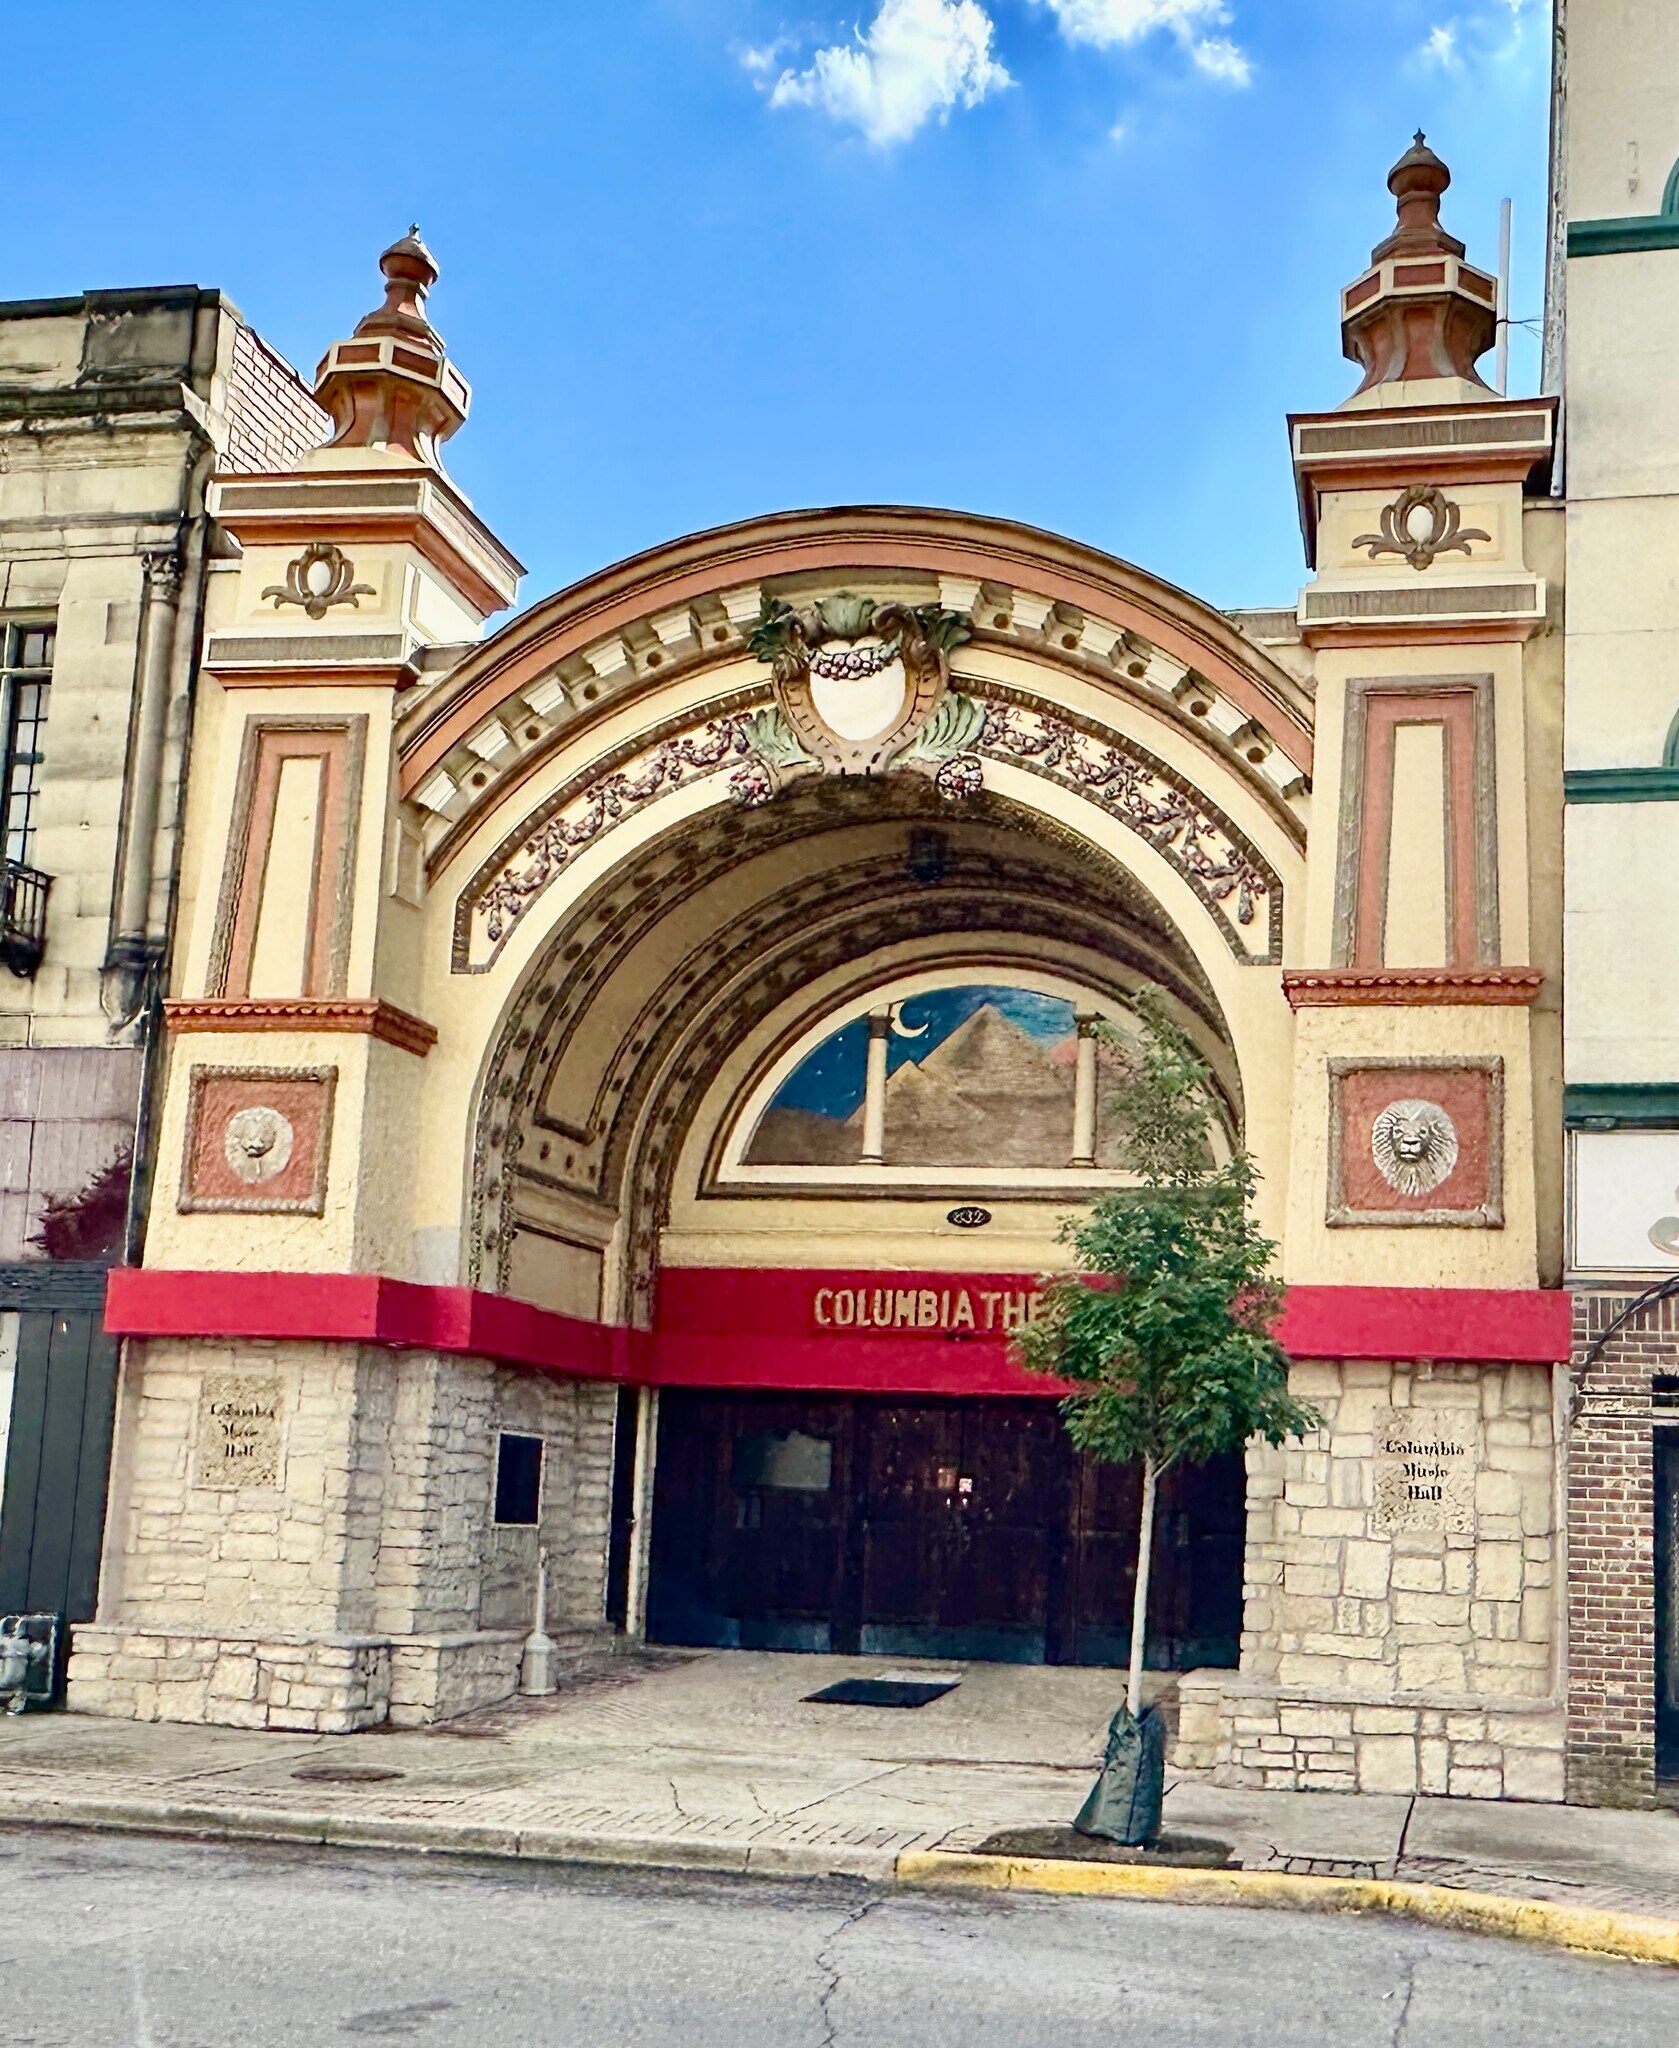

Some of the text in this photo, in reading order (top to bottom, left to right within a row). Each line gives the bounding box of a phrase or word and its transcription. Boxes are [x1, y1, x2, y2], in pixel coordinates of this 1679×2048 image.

[814, 1287, 1046, 1331] COLUMBIA THE
[1386, 1440, 1465, 1456] Columbia
[1408, 1485, 1442, 1500] Hall
